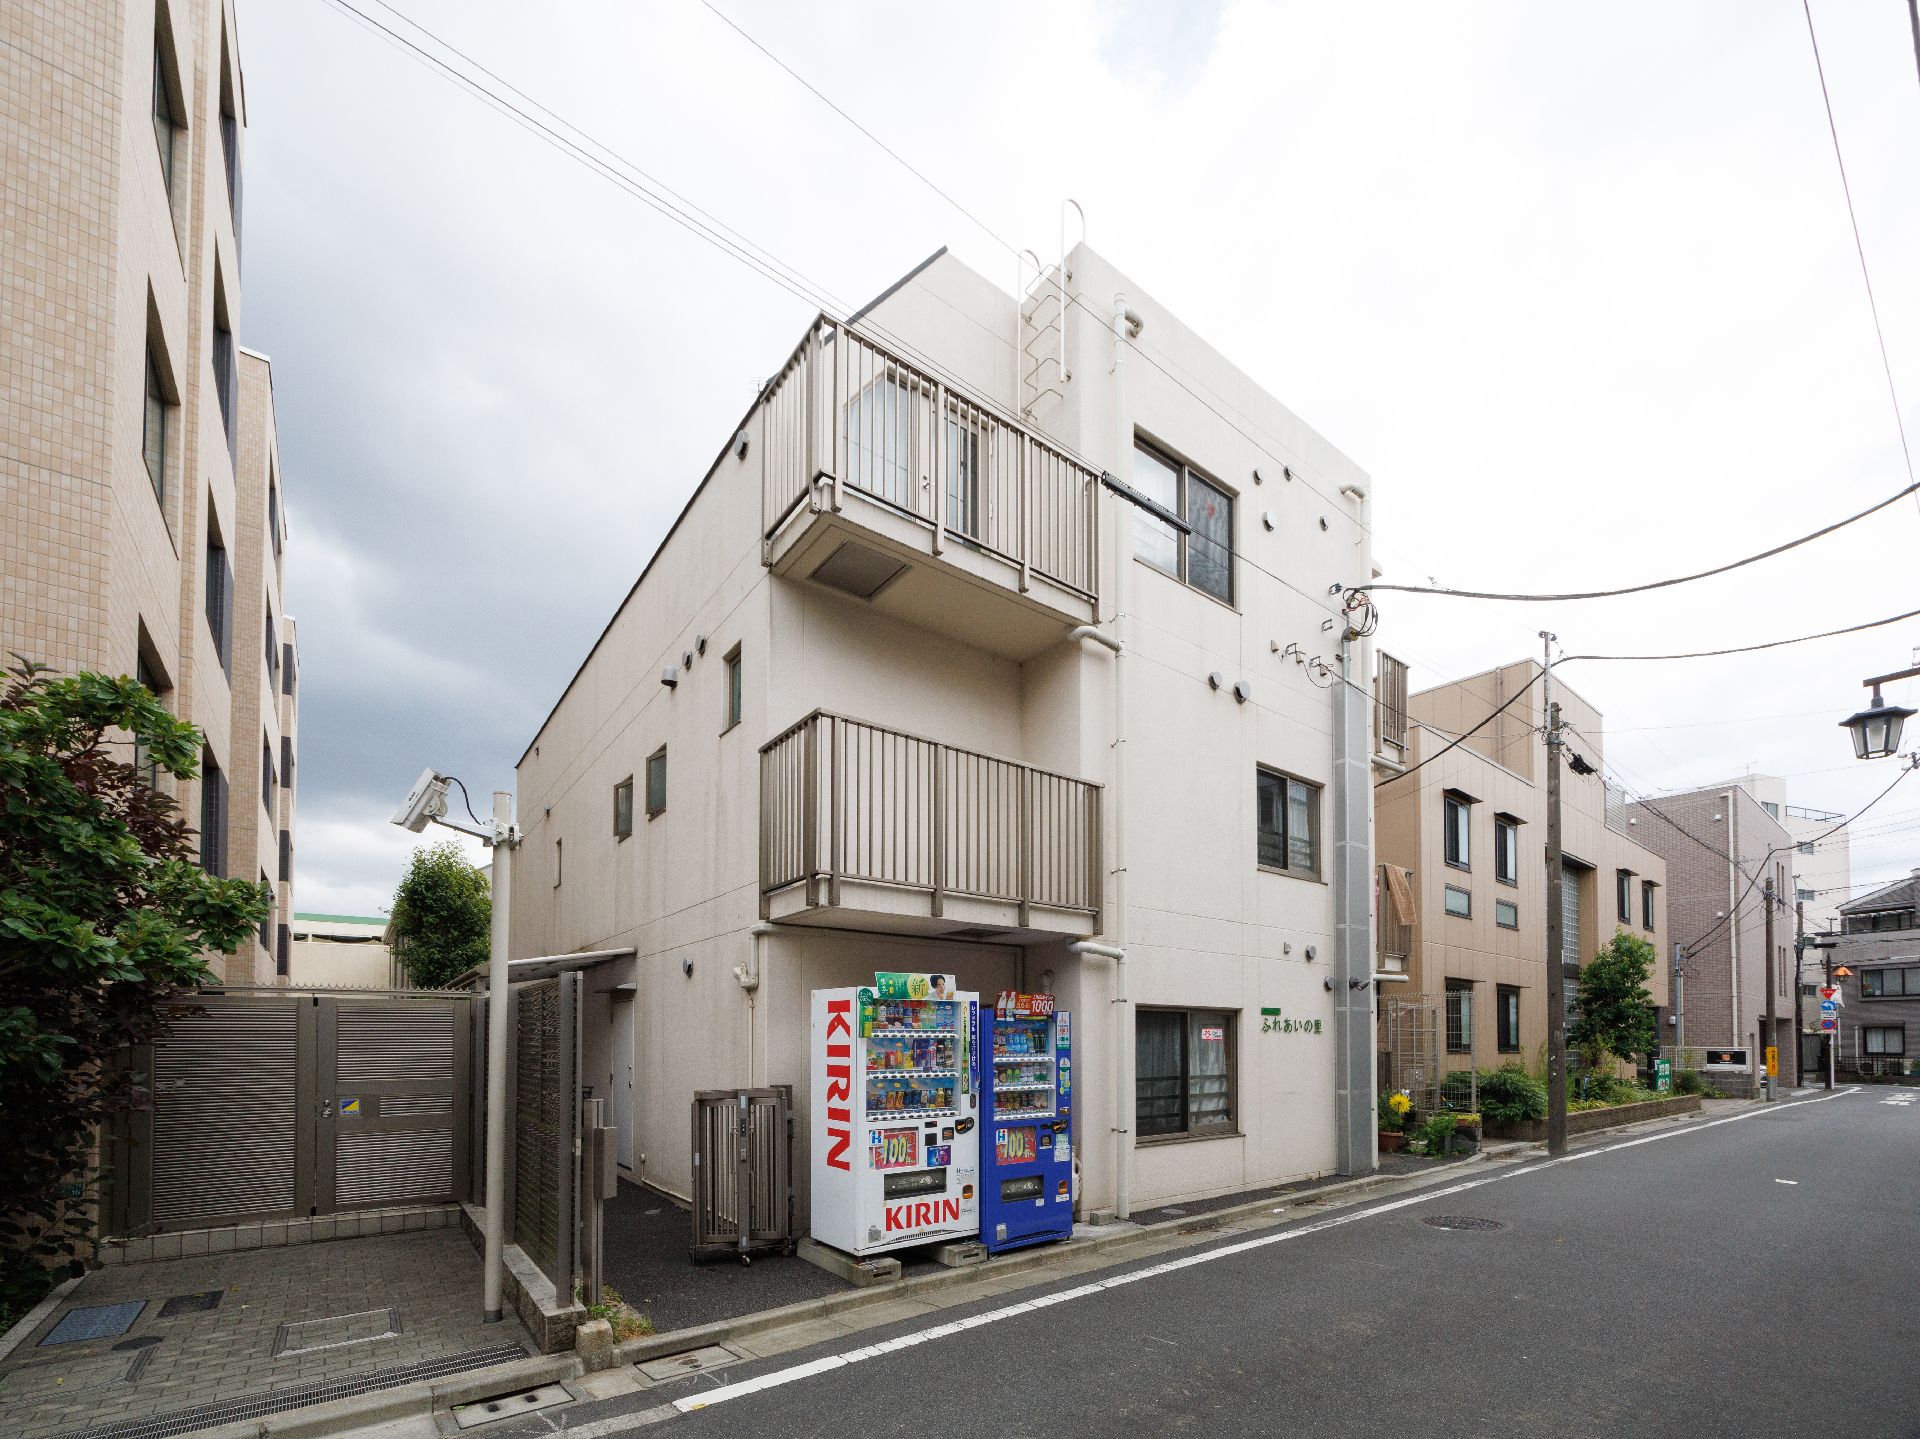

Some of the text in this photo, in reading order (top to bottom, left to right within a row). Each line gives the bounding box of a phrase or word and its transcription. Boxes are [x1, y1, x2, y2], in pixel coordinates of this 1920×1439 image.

[1031, 1000, 1054, 1013] 1000
[1260, 1017, 1322, 1035] ふれあいの里
[826, 1000, 851, 1172] KIRIN
[885, 1197, 960, 1232] KIRIN
